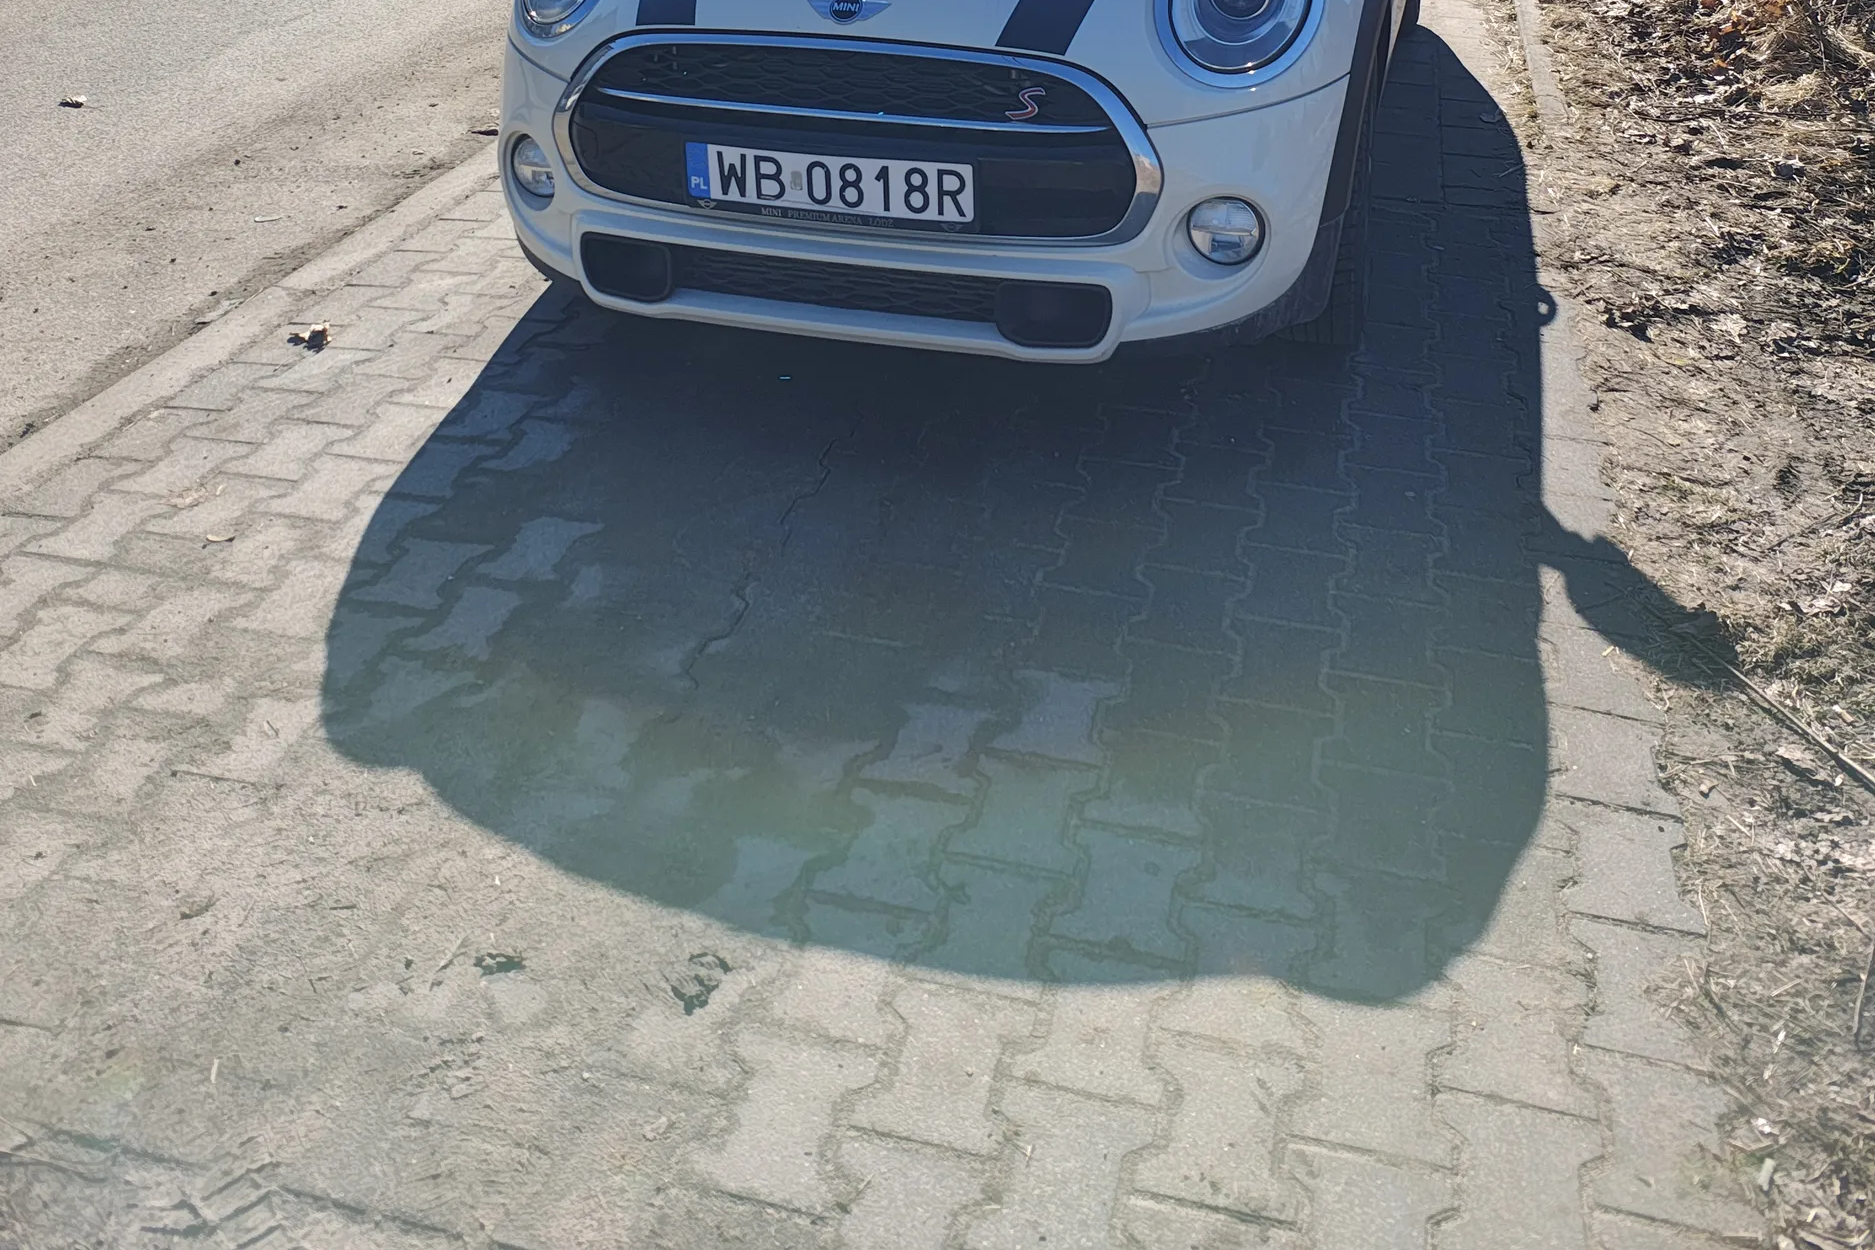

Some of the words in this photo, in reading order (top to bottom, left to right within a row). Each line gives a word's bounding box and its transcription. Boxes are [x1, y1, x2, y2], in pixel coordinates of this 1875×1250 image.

[832, 2, 860, 12] MINI
[1005, 87, 1046, 120] S
[690, 176, 708, 190] PL
[715, 150, 787, 201] WB
[805, 160, 968, 218] 0818R
[761, 206, 782, 218] MINI
[787, 209, 831, 223] PREMIUM
[831, 214, 863, 226] ARENA
